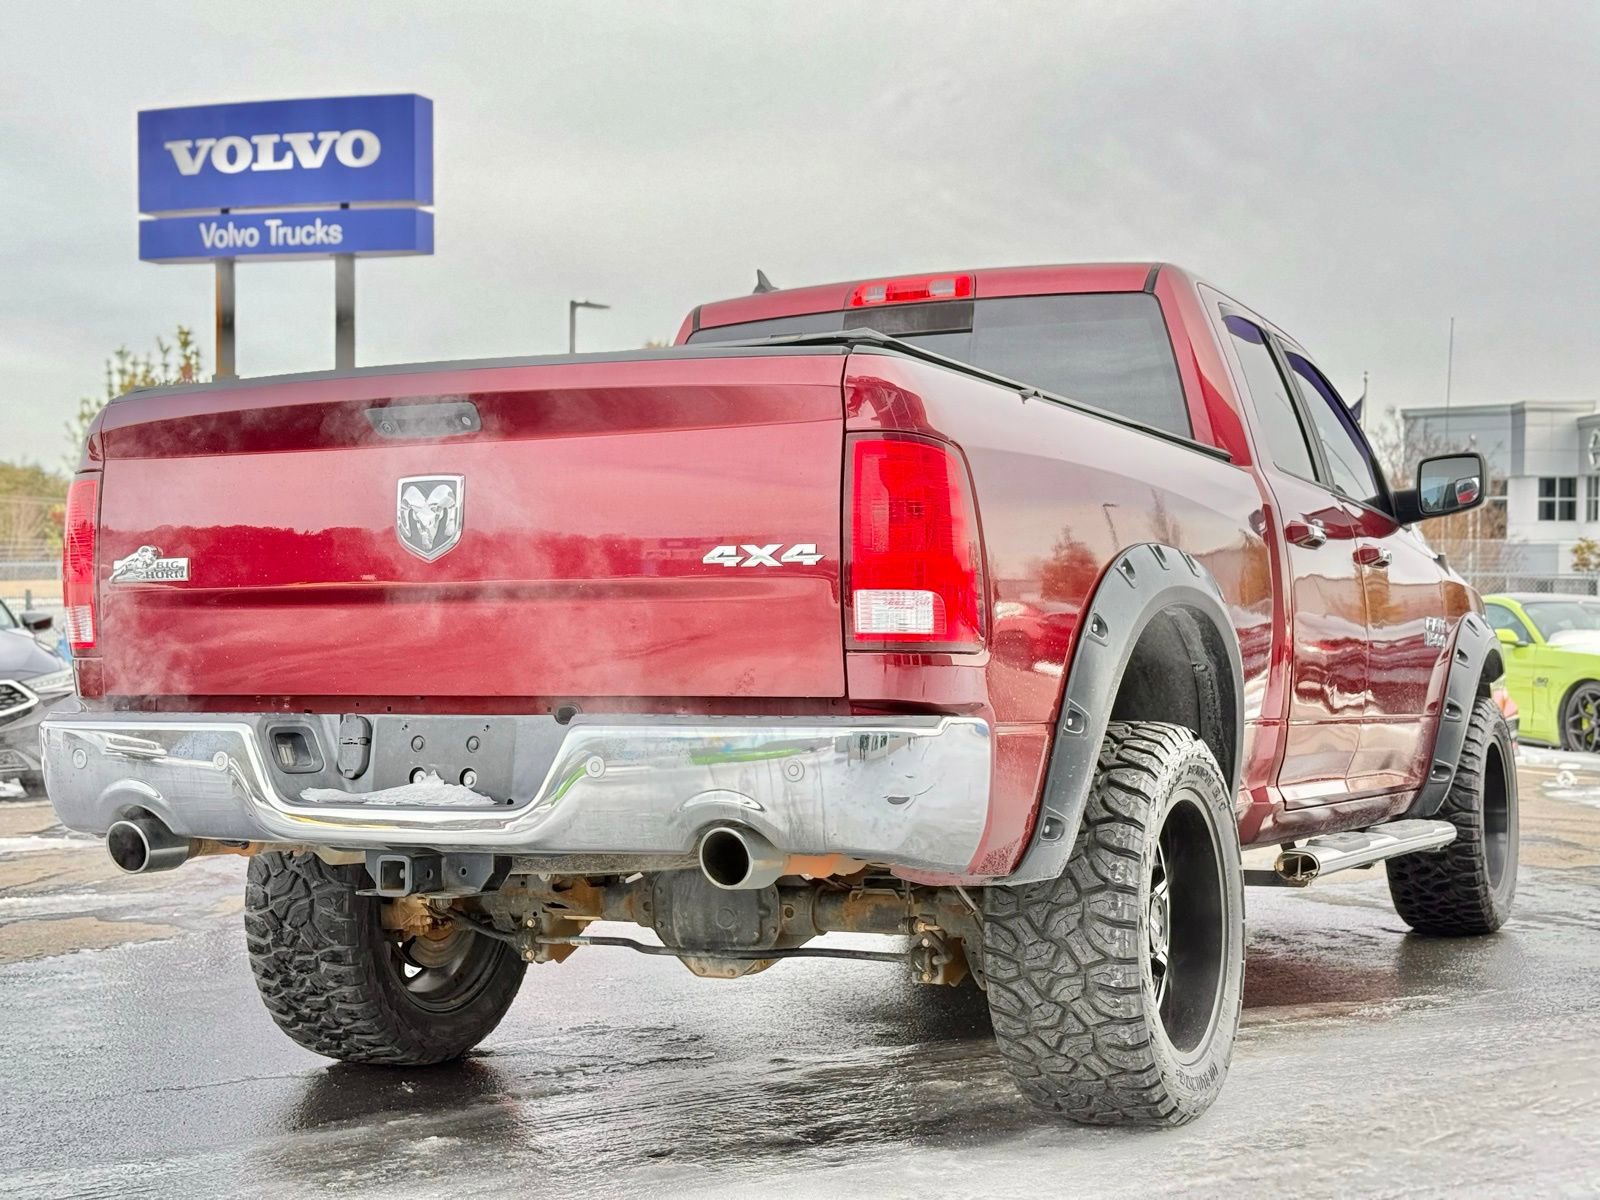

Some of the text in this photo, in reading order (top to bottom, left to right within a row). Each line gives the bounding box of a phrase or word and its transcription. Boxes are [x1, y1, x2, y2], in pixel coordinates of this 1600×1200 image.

[163, 129, 381, 176] VOLVO
[199, 218, 343, 249] Volvo Trucks
[156, 561, 180, 569] BIG
[702, 543, 825, 567] 4X4
[144, 570, 185, 579] HORN
